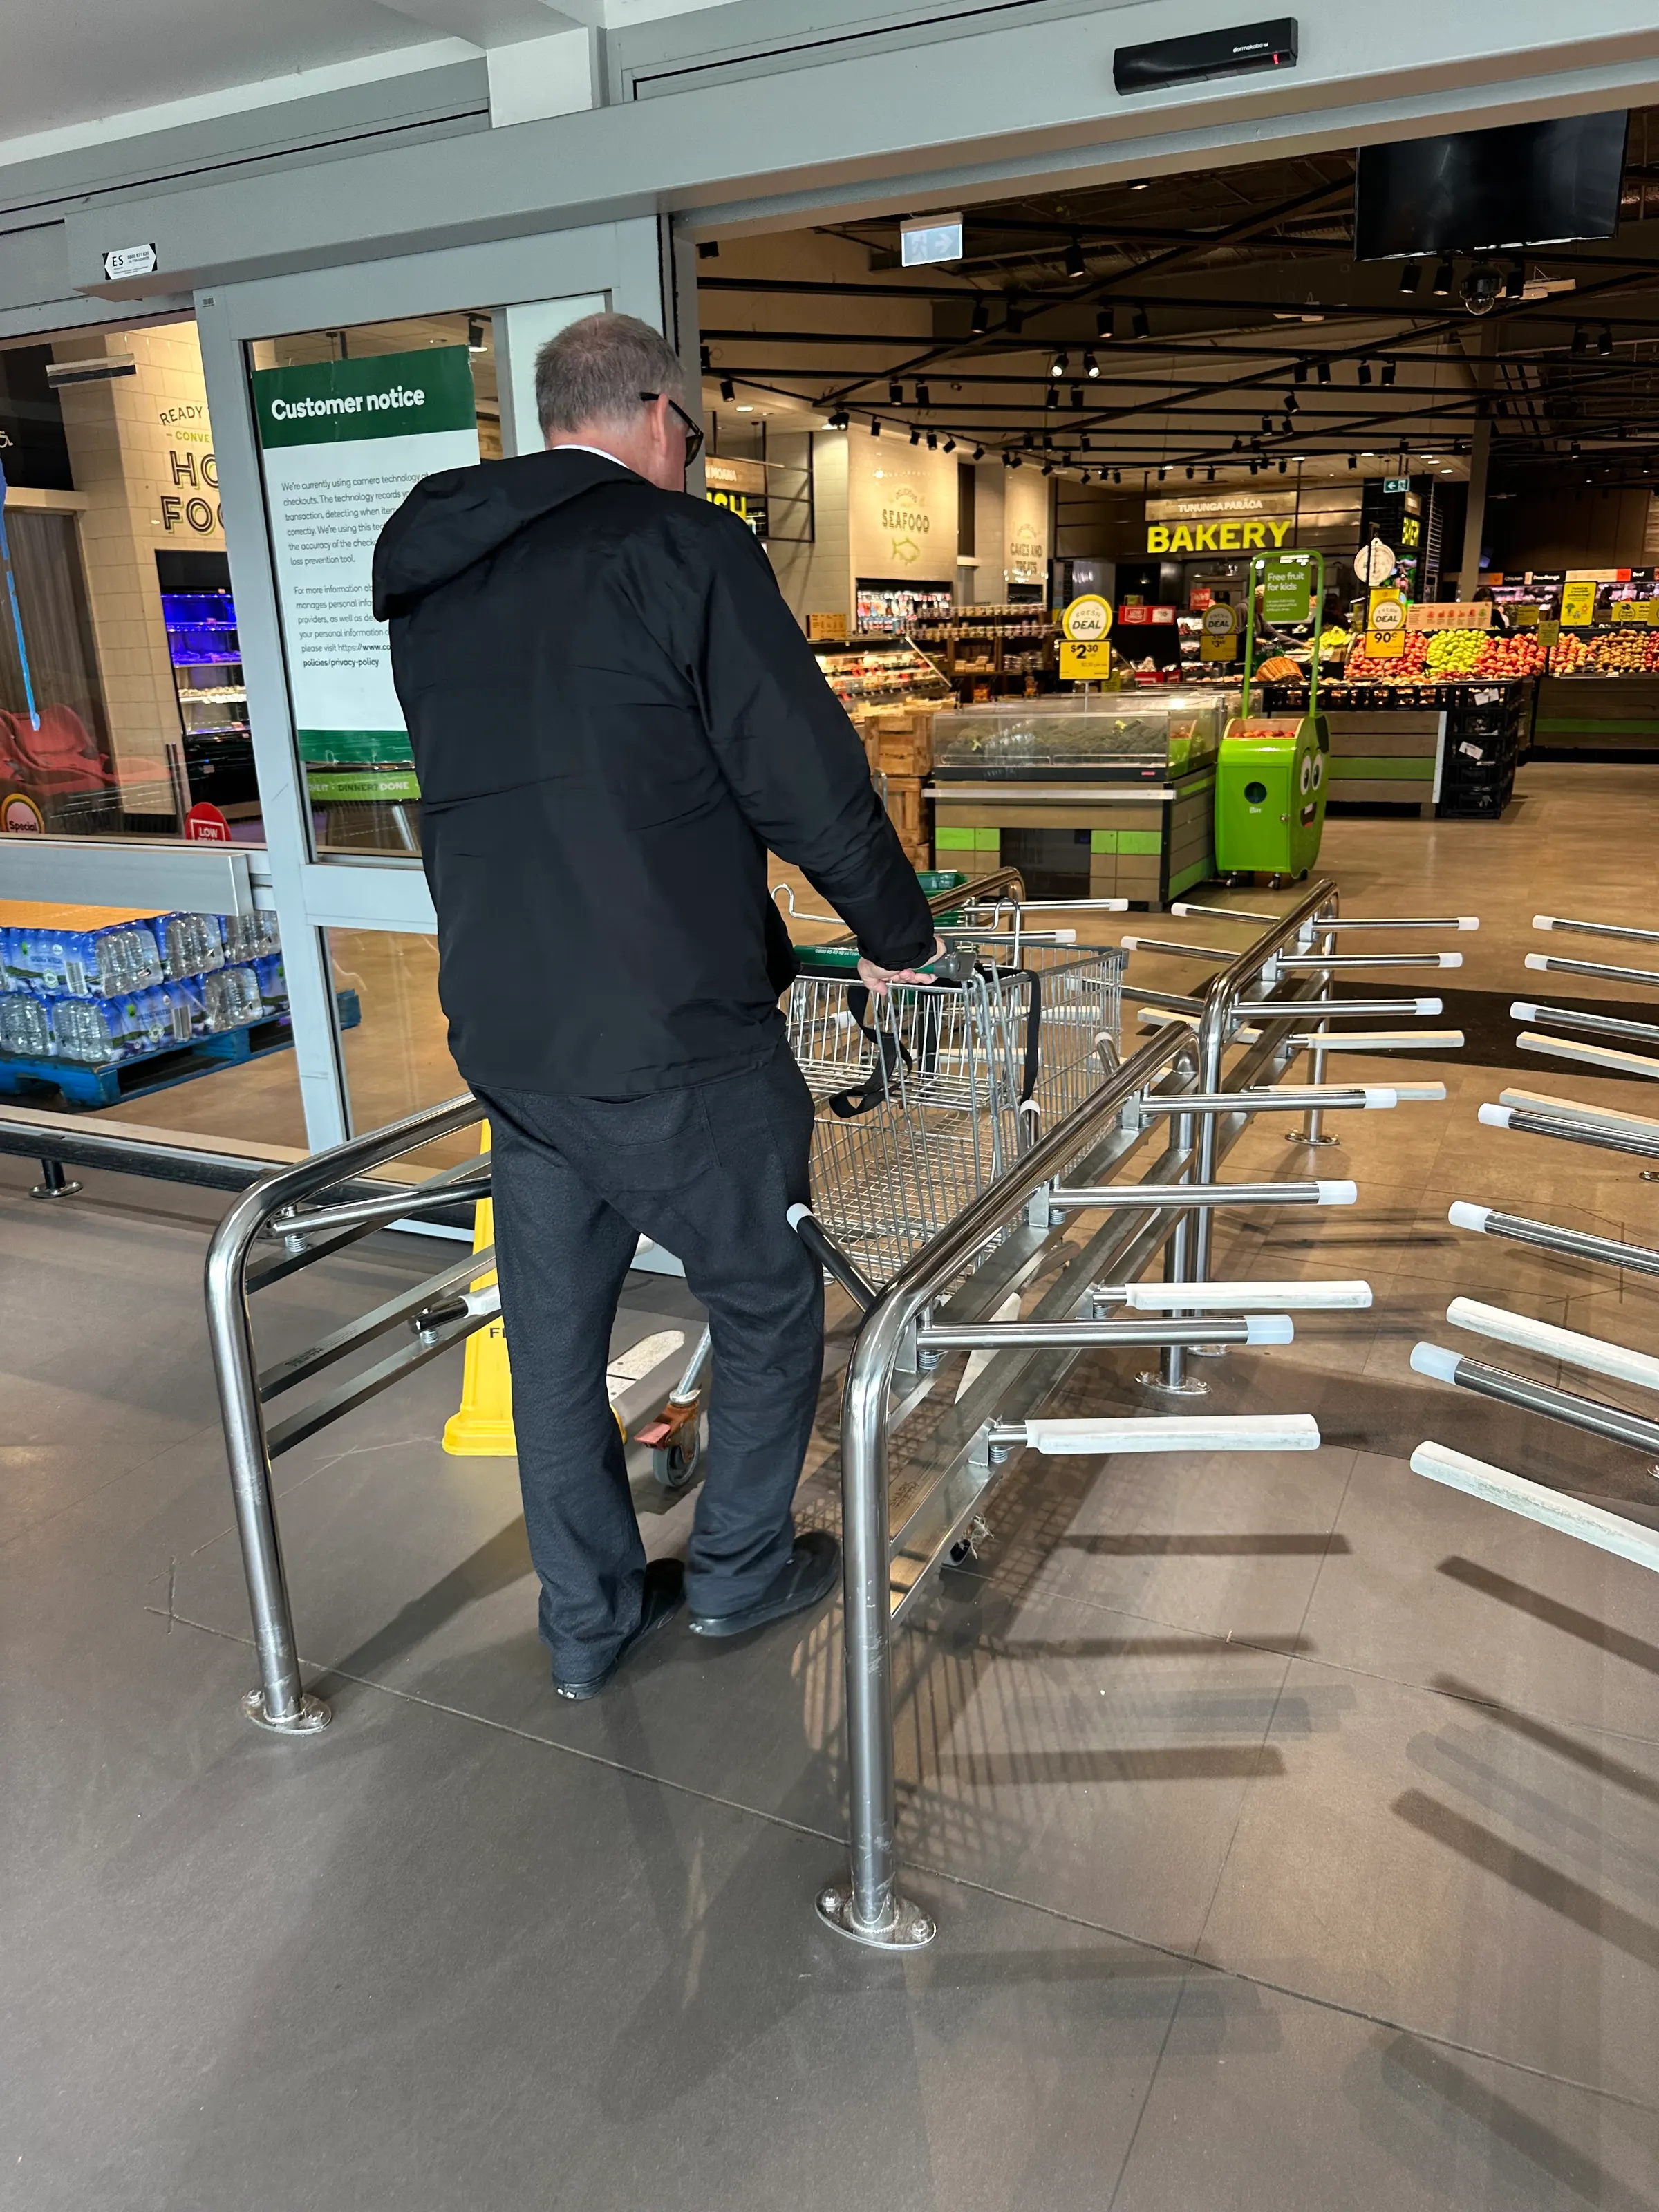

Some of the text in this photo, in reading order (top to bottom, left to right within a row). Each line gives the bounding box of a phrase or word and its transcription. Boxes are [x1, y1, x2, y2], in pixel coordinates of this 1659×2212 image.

[112, 254, 124, 267] ES
[271, 385, 425, 420] Customer notice
[159, 406, 203, 426] READY
[281, 482, 301, 491] We're
[301, 480, 330, 489] currently
[332, 478, 351, 488] using
[353, 477, 380, 485] camera
[381, 474, 420, 483] technology
[283, 497, 319, 506] checkouts.
[319, 495, 333, 503] The
[334, 492, 374, 503] technology
[375, 489, 401, 499] records
[160, 496, 225, 535] FO
[285, 512, 324, 521] transaction,
[325, 509, 359, 518] detecting
[360, 507, 379, 516] when
[882, 509, 930, 533] SEAFOOD
[287, 527, 317, 536] correctly.
[317, 525, 337, 534] We're
[337, 524, 357, 534] using
[358, 523, 371, 532] this
[1147, 521, 1292, 553] BAKERY
[301, 543, 331, 551] accuracy
[332, 539, 339, 548] of
[290, 554, 355, 566] loss prevention tool.
[1267, 572, 1305, 581] Free fruit
[294, 586, 304, 594] For
[324, 585, 362, 593] information
[1267, 582, 1297, 591] for kids
[296, 602, 327, 610] manages
[328, 599, 357, 610] personal
[298, 615, 328, 625] providers,
[339, 614, 353, 622] well
[1072, 620, 1101, 630] DEAL
[299, 632, 312, 640] your
[314, 629, 342, 639] personal
[344, 628, 384, 637] information
[301, 644, 323, 653] please
[303, 657, 379, 668] policies/privacy-policy
[380, 781, 410, 791] DONE
[9, 820, 37, 832] Special
[199, 827, 218, 838] LOW
